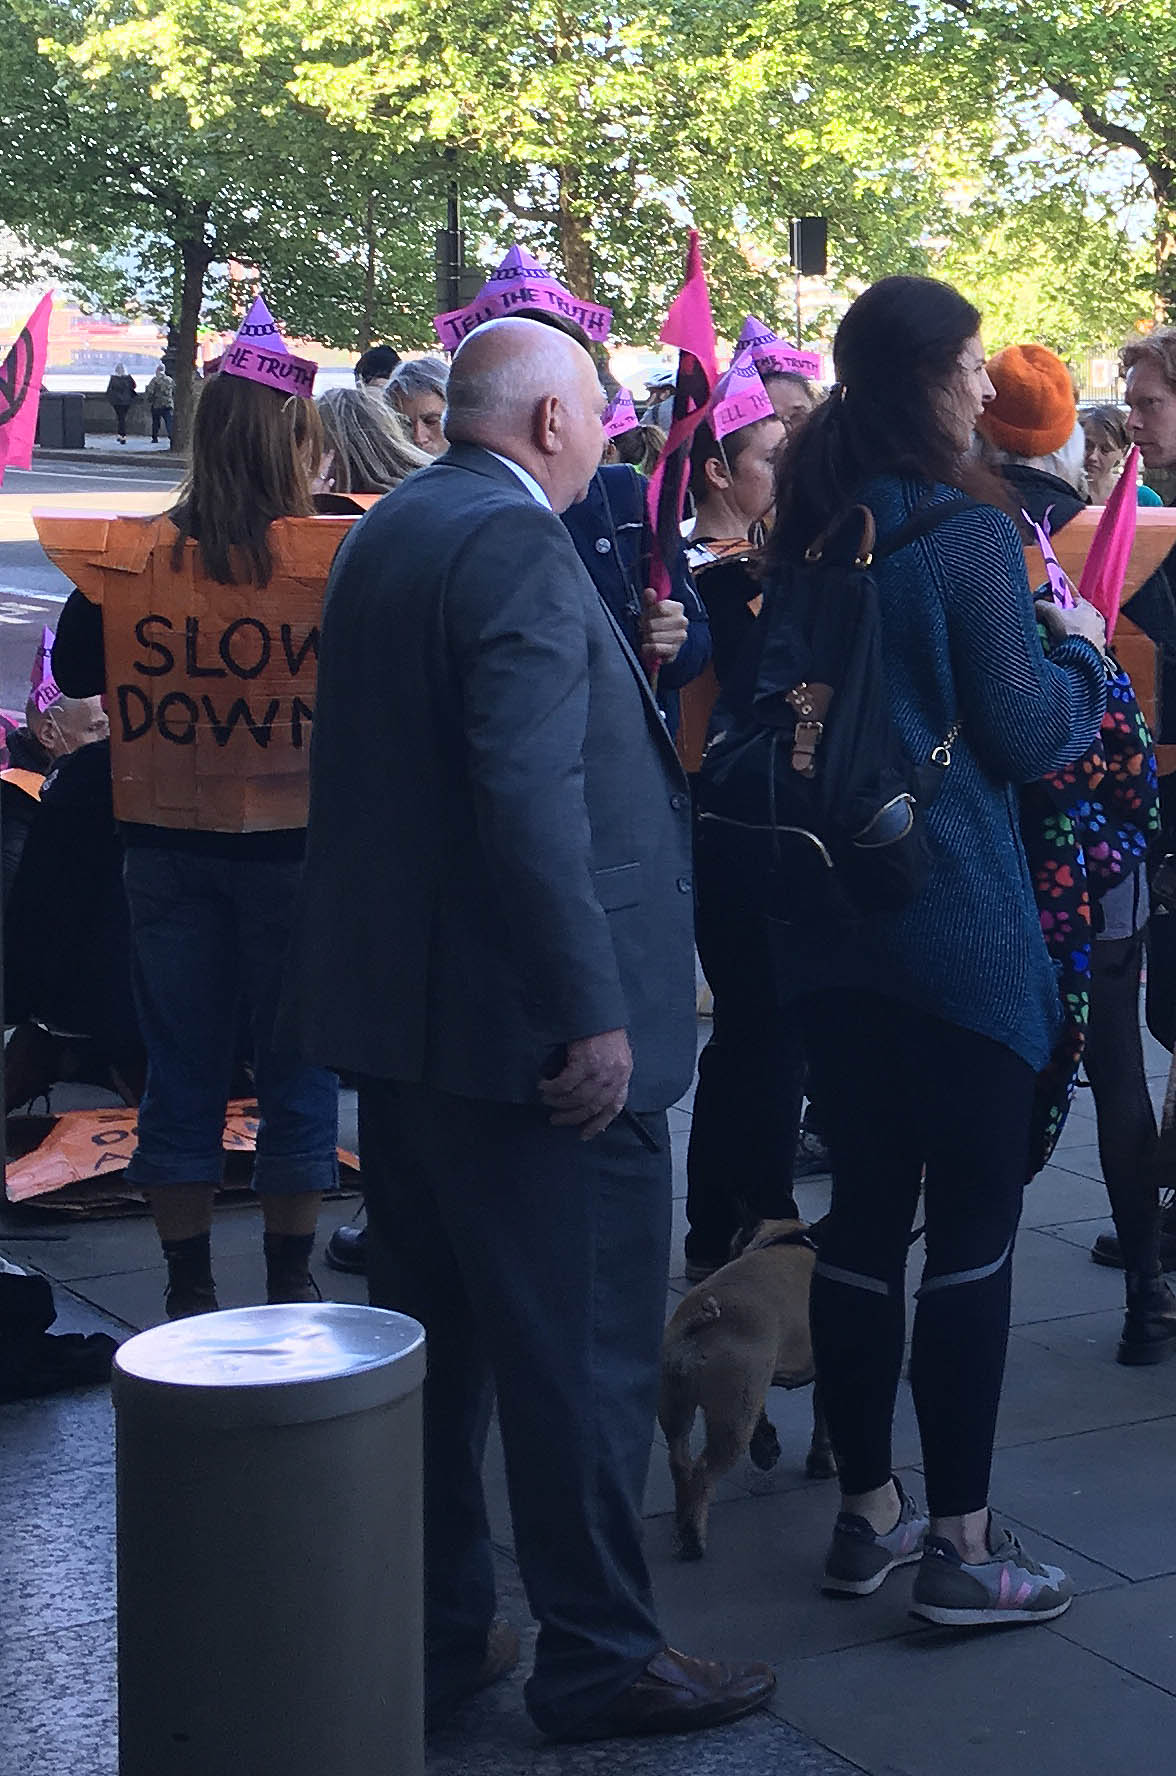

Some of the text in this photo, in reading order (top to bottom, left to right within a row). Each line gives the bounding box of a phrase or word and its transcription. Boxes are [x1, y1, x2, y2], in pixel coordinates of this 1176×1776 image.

[500, 287, 540, 308] THE
[545, 290, 605, 329] TRUTH
[257, 353, 317, 385] TRUTH
[133, 613, 321, 680] SLOW
